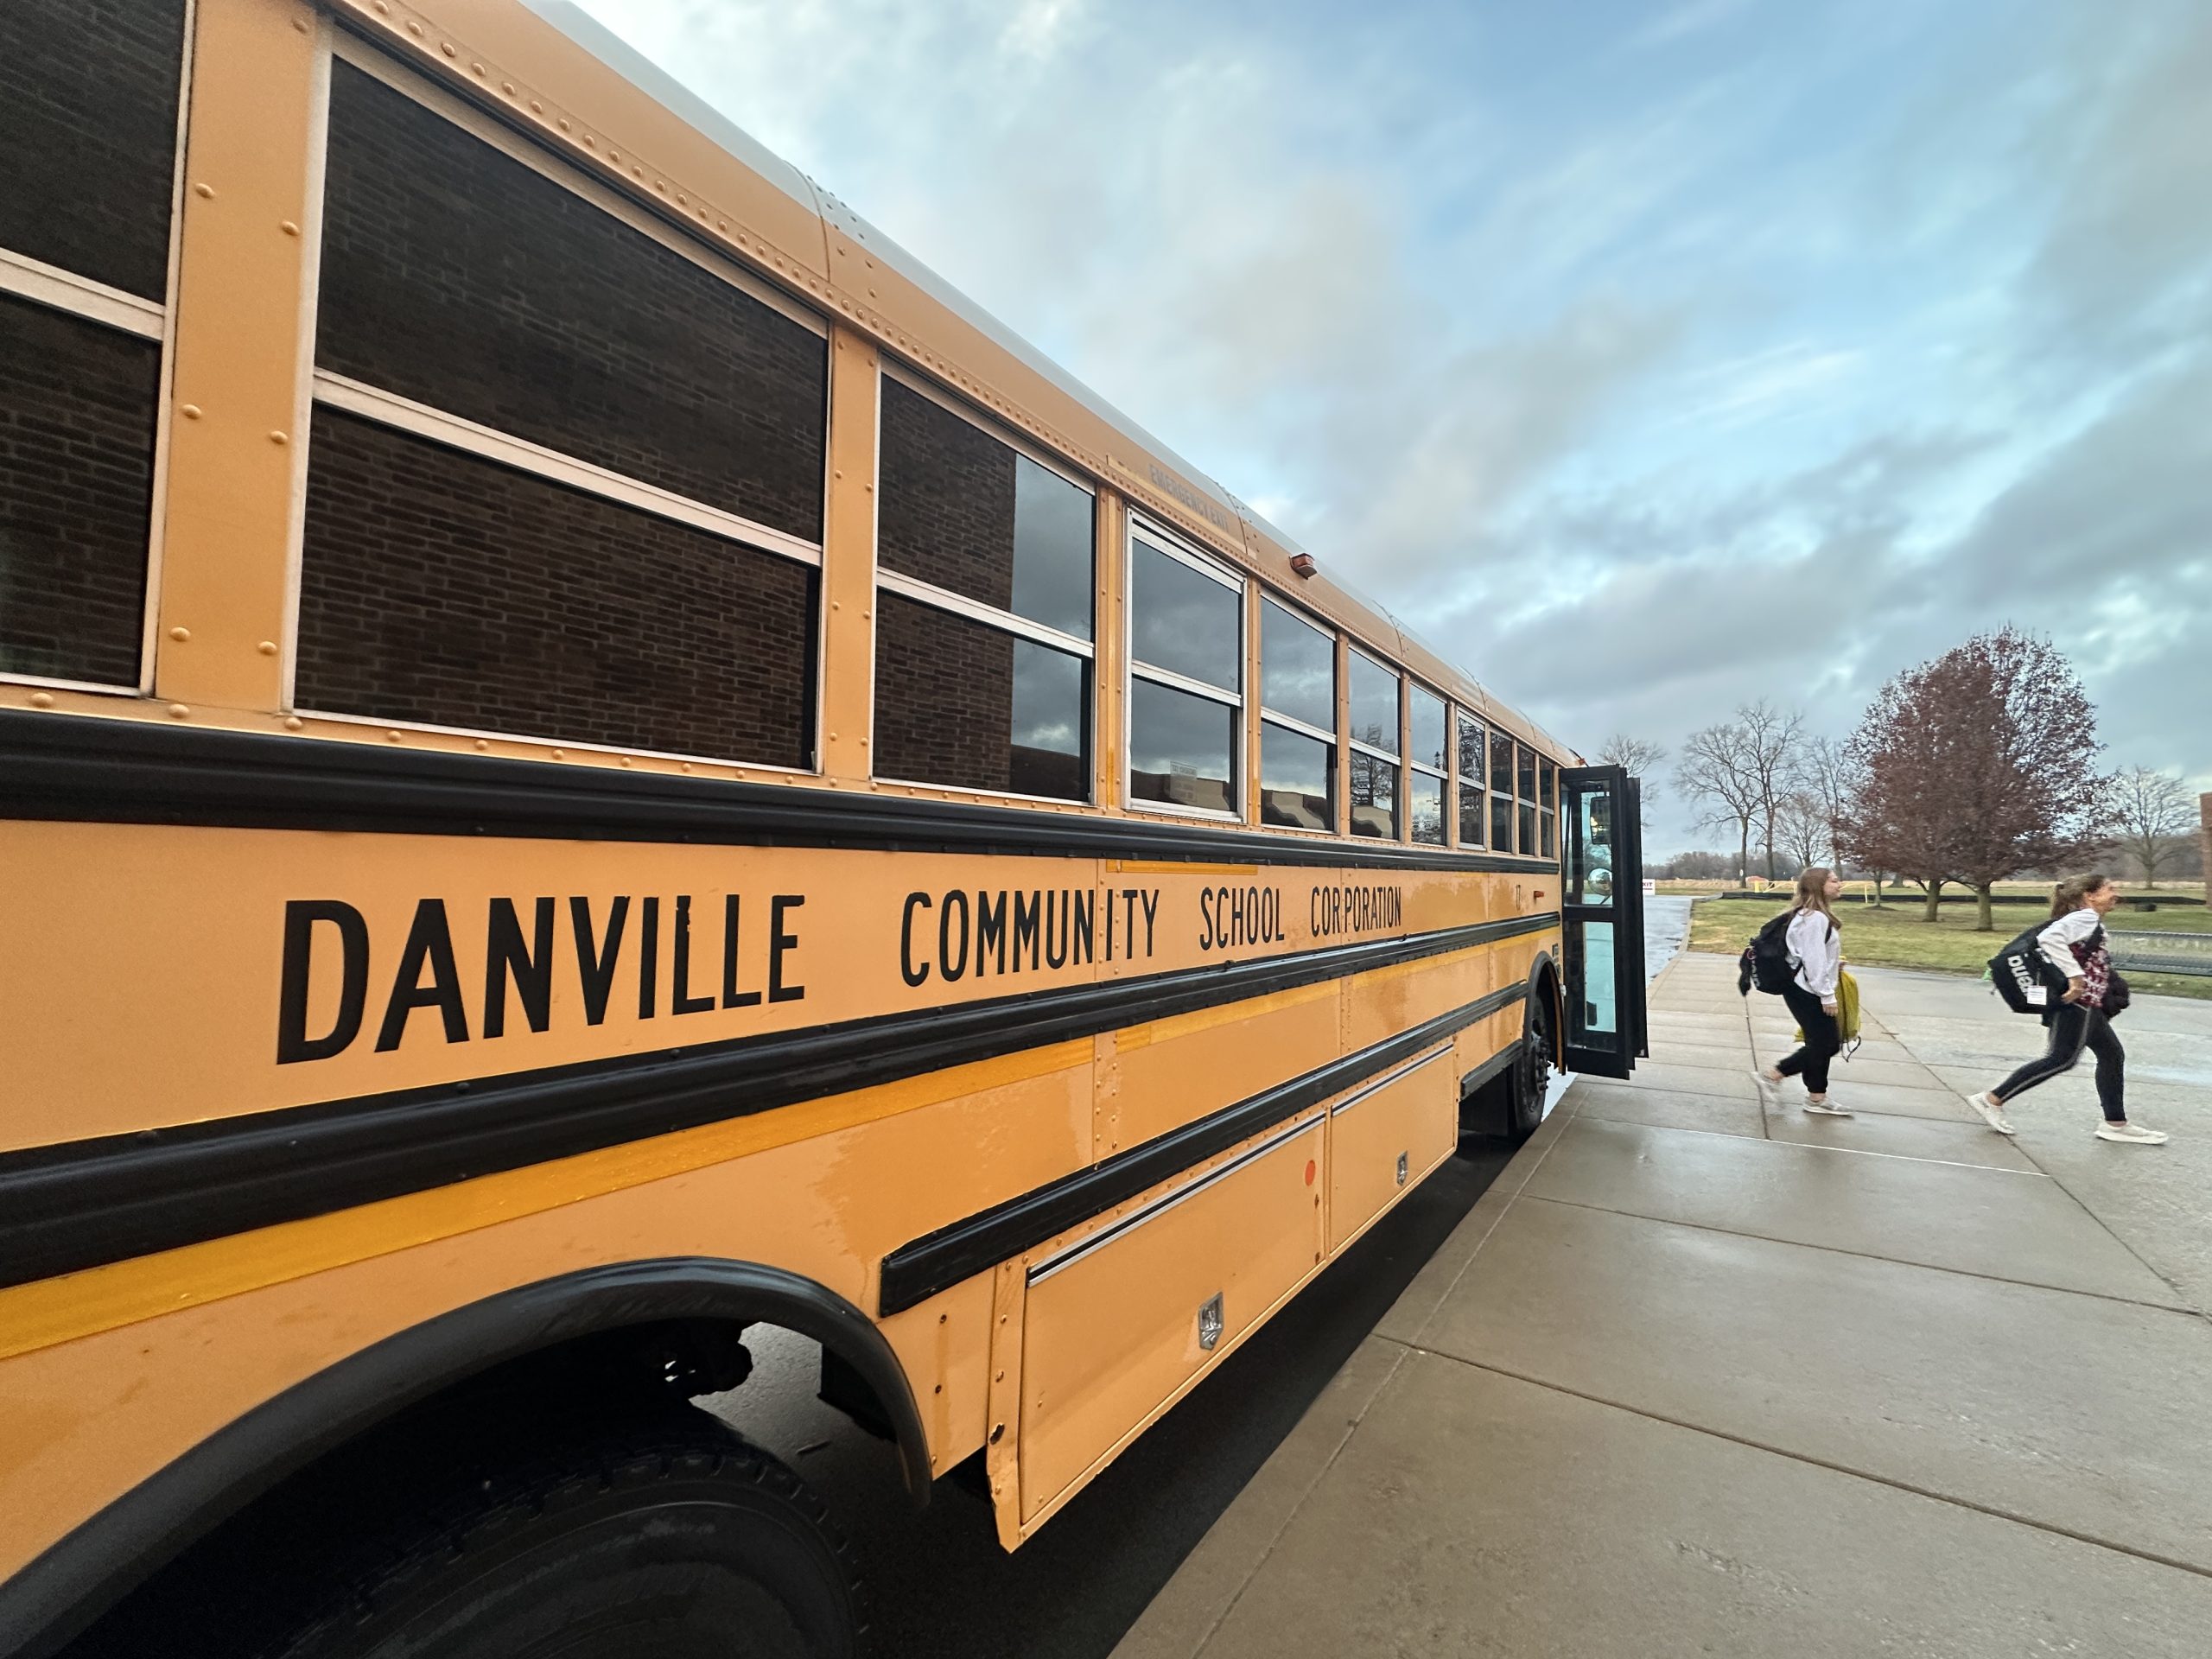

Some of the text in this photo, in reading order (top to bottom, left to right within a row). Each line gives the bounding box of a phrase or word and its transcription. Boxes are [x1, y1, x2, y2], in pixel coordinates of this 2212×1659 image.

[1147, 463, 1229, 533] EMERGENCY EXIT
[276, 886, 1402, 1065] DANVILLE COMMUNITY SCHOOL CORPORATION
